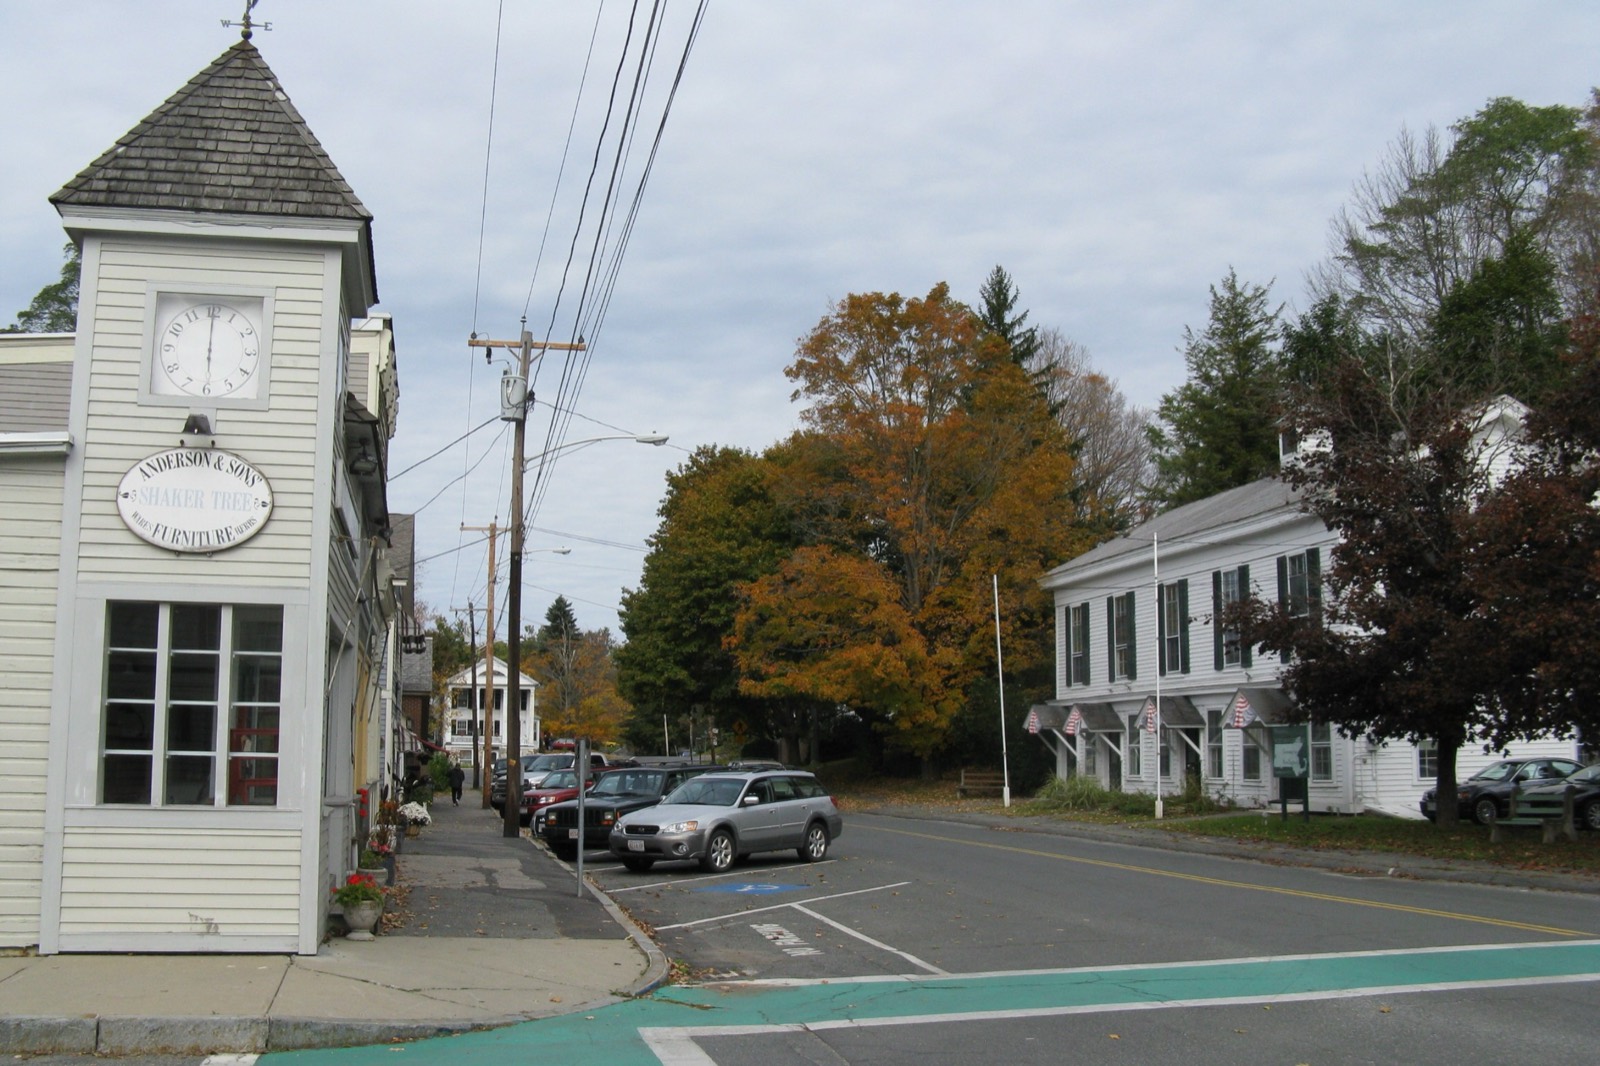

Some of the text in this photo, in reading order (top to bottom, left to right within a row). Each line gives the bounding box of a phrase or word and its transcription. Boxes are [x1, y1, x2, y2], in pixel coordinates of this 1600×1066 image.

[220, 19, 230, 28] W
[264, 22, 273, 31] E
[185, 309, 200, 323] 11
[227, 313, 237, 324] 1
[168, 322, 184, 338] 10
[240, 327, 253, 338] 2
[163, 343, 175, 353] 9
[244, 347, 257, 357] 3
[166, 362, 180, 374] 8
[239, 367, 250, 378] 4
[181, 376, 194, 388] 7
[223, 378, 233, 391] 5
[202, 383, 211, 396] 6
[138, 451, 212, 482] ANDERSON
[213, 455, 224, 471] &
[138, 486, 253, 512] SHAKER TREE
[151, 525, 236, 547] FURNITURE
